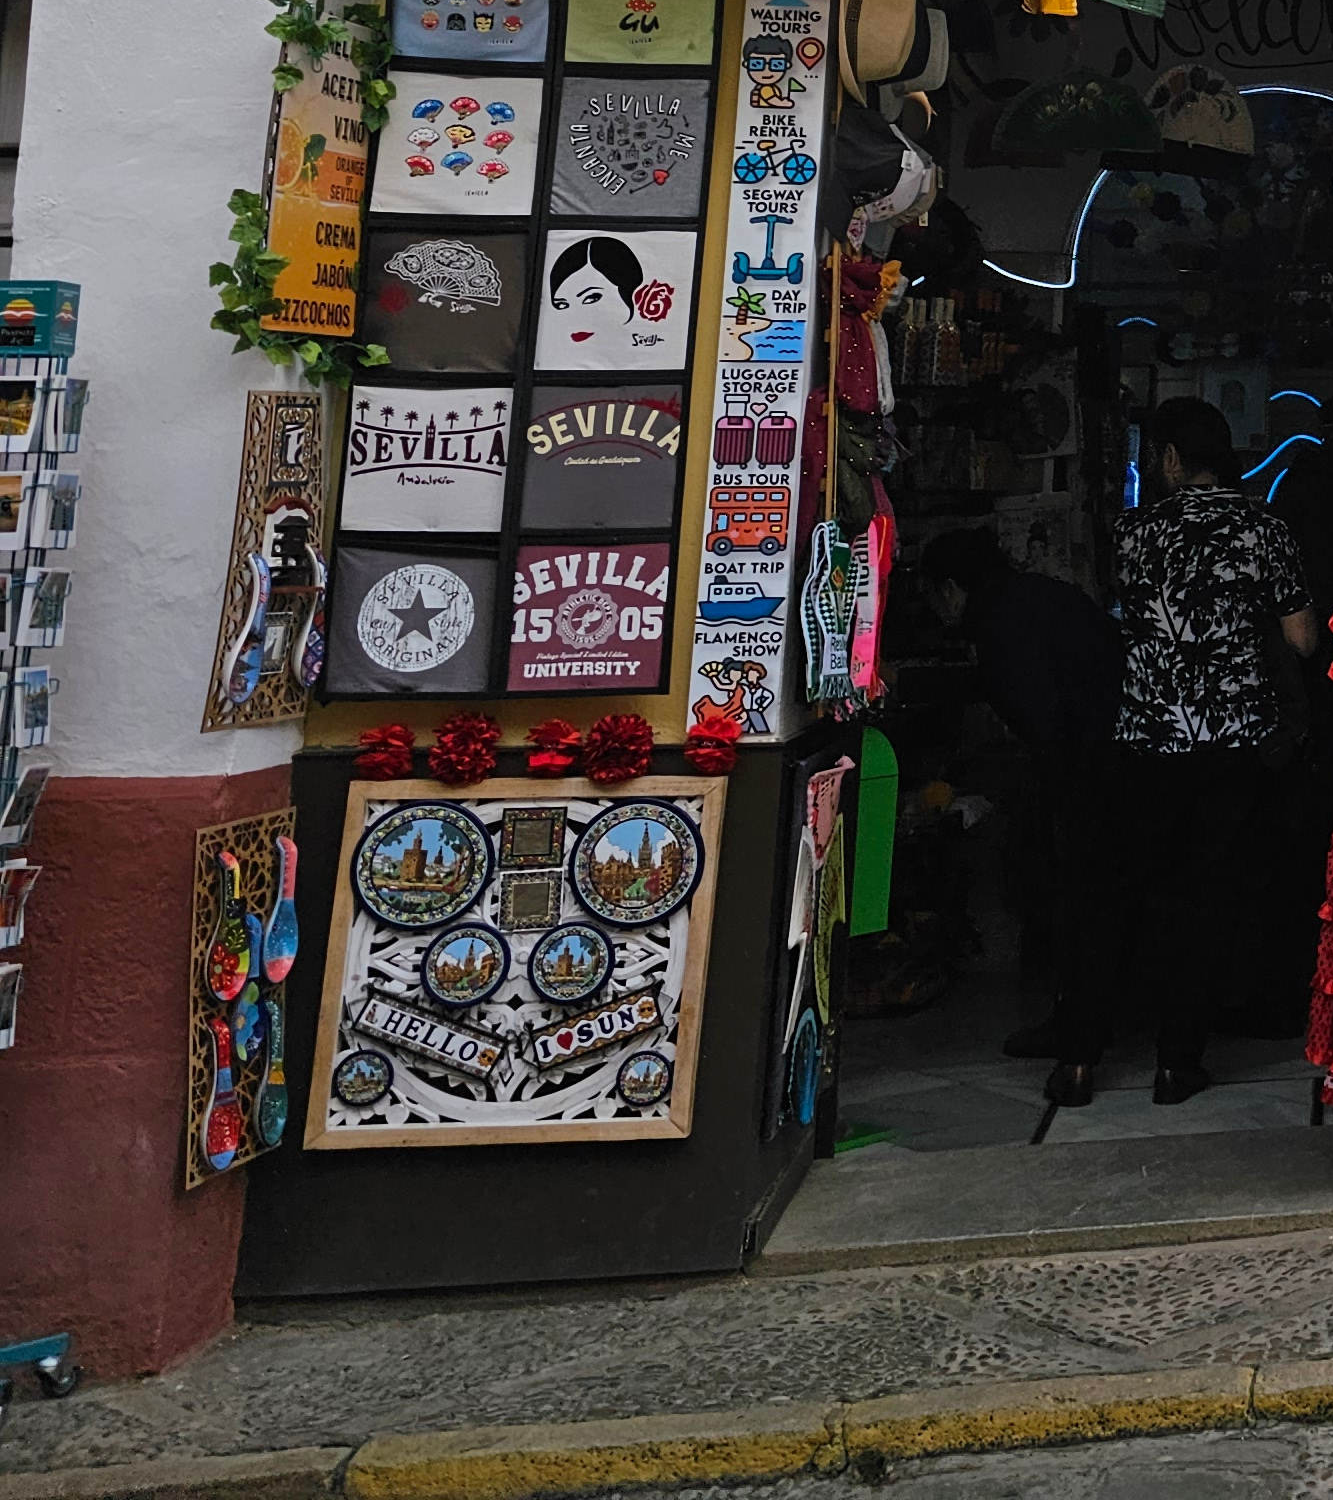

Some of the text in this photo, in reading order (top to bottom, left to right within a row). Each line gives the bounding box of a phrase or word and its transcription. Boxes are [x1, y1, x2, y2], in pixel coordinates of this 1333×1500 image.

[750, 8, 822, 23] WALKING
[761, 21, 811, 35] TOURS
[321, 71, 366, 105] ACEIT
[589, 92, 681, 120] SEVILLA
[762, 114, 796, 127] BIKE
[334, 115, 365, 145] VINO
[749, 125, 808, 138] RENTAL
[669, 131, 697, 160] ME
[570, 123, 627, 195] ENCANTA
[742, 188, 804, 202] SEGWAY
[747, 201, 798, 214] TOURS
[315, 220, 356, 250] CREMA
[312, 259, 353, 290] JABÓN
[771, 289, 802, 302] DAY
[774, 301, 807, 314] TRIP
[722, 368, 799, 382] LUGGAGE
[722, 380, 796, 393] STORAGE
[526, 403, 681, 456] SEVILLA
[350, 426, 508, 467] SEVILLA
[713, 473, 790, 486] BUS TOUR
[704, 561, 785, 574] BOAT TRIP
[512, 552, 670, 605] SEVILLA
[511, 608, 554, 642] 15
[619, 606, 664, 641] 05
[694, 631, 783, 645] FLAMENCO
[732, 644, 781, 657] SHOW
[523, 661, 641, 678] UNIVERSITY
[381, 1008, 480, 1062] HELLO
[538, 1006, 637, 1060] I SUN
